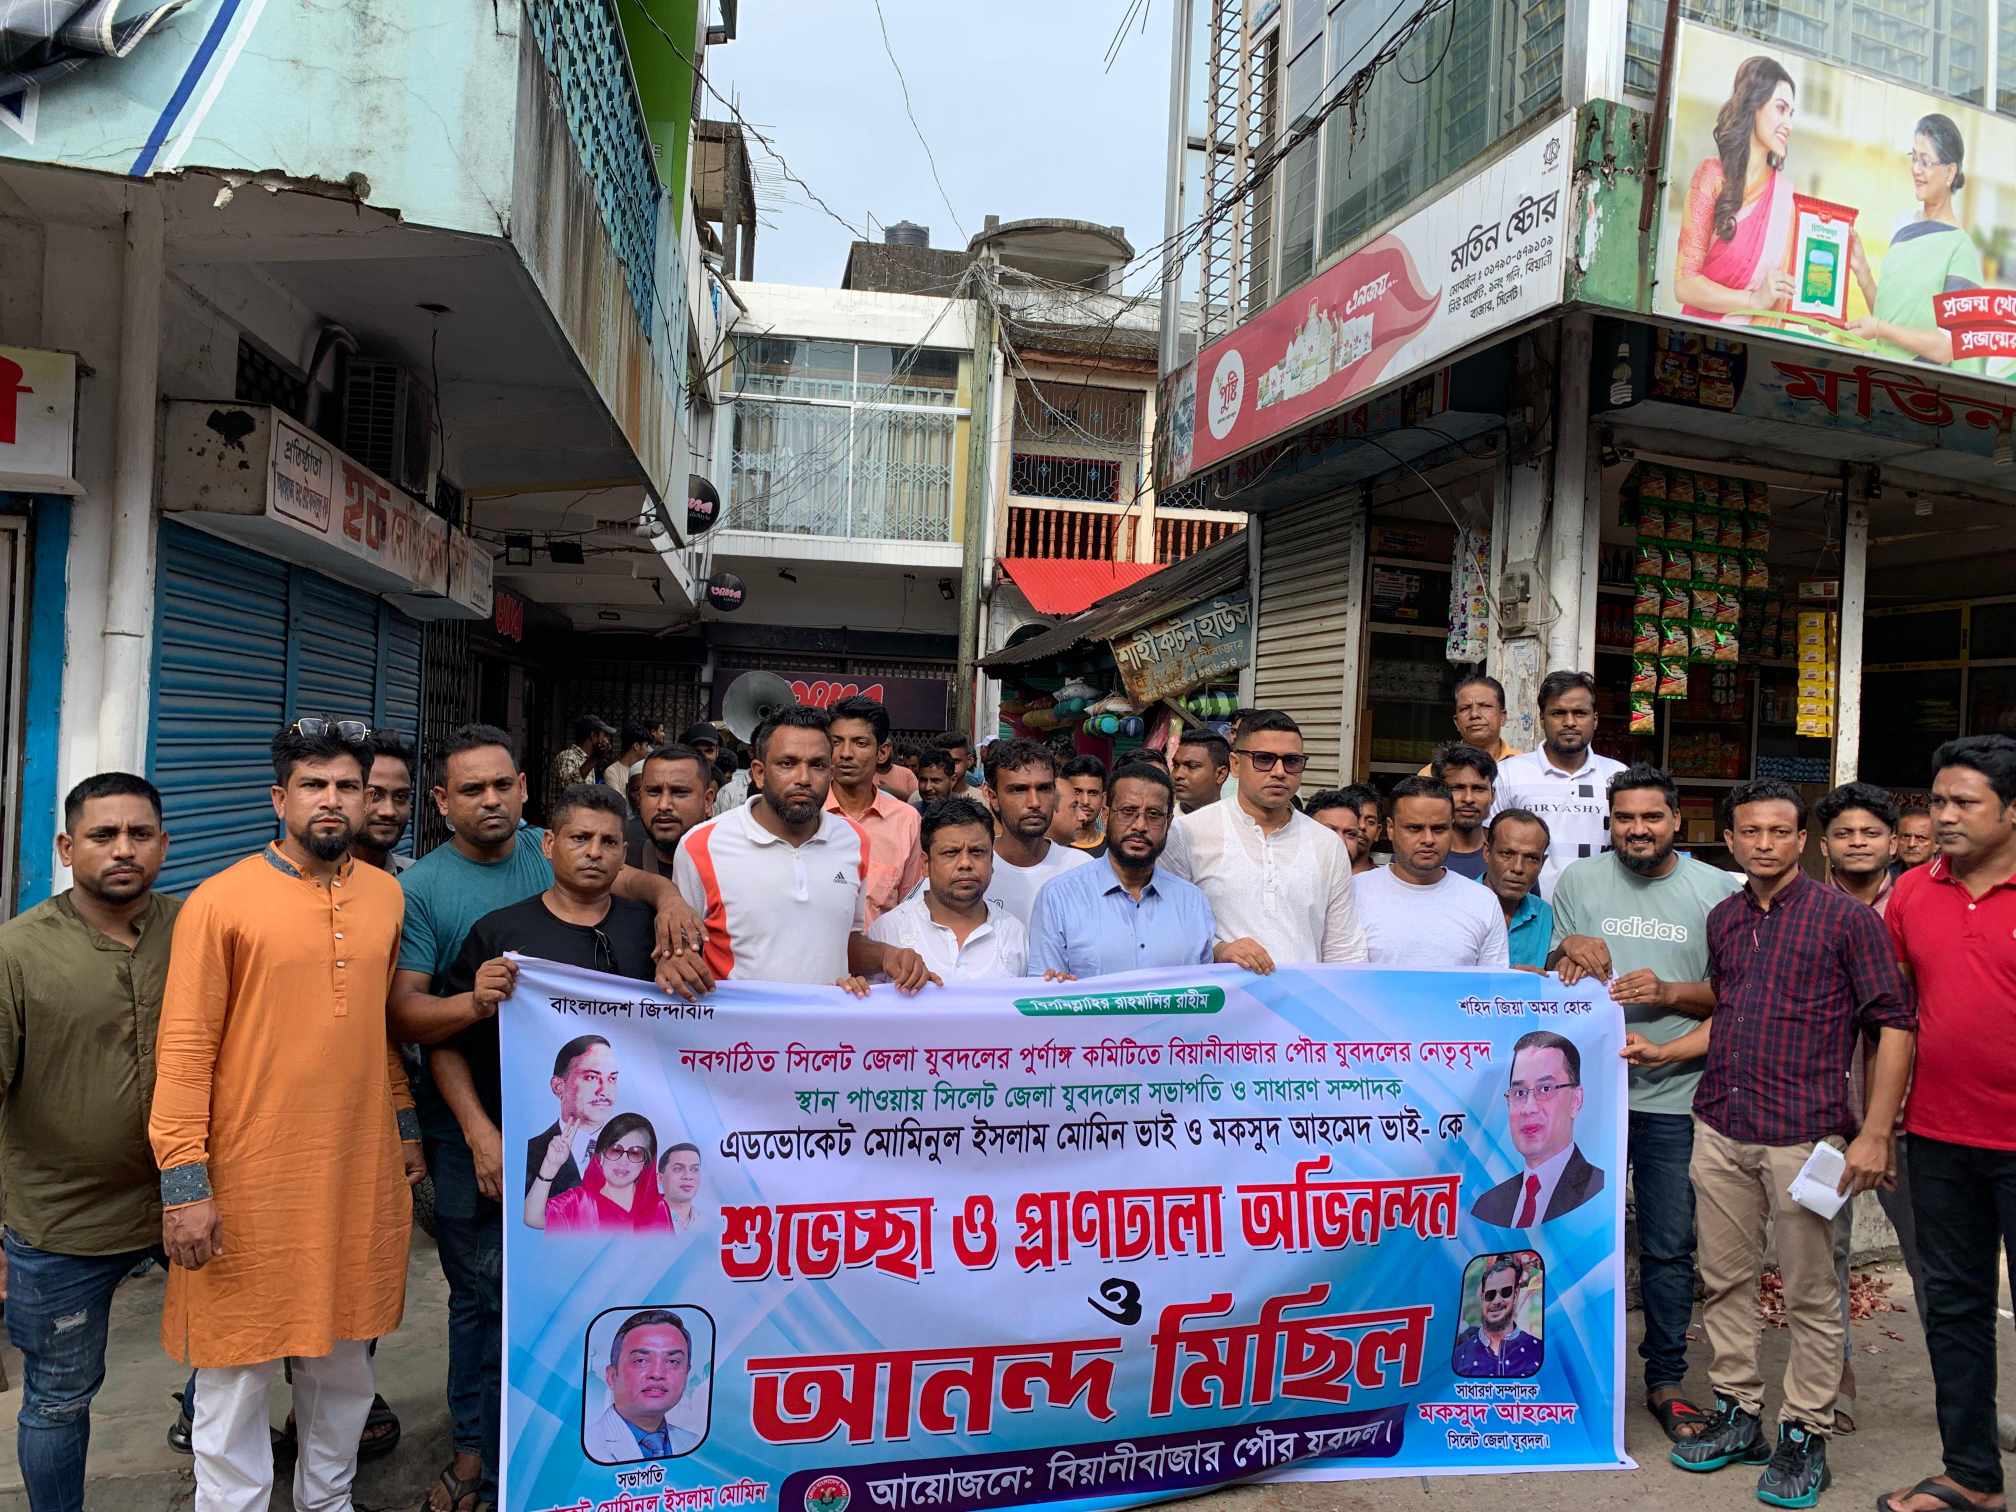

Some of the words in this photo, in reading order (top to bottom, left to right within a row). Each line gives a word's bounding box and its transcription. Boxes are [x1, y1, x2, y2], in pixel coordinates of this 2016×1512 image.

[1451, 221, 1501, 272] মতিন
[1506, 189, 1560, 242] ষ্টোর
[1943, 295, 1990, 318] প্রজন্ম
[1116, 628, 1161, 671] শাহী
[1196, 600, 1251, 641] হাউস
[1602, 916, 1687, 943] adidas
[549, 996, 634, 1018] বাংলাদেশ
[640, 997, 716, 1020] জিন্দাবাদ
[1458, 996, 1491, 1015] শহিদ
[1495, 996, 1524, 1015] জিয়া
[1528, 1000, 1558, 1015] অমর
[1563, 999, 1592, 1015] হোক
[679, 1041, 780, 1074] নবগঠিত
[786, 1041, 856, 1074] সিলেট
[863, 1046, 918, 1073] জেলা
[924, 1047, 1012, 1077] যুবদলের
[1081, 1037, 1163, 1068] কমিটিতে
[1168, 1035, 1278, 1066] বিয়ানীবাজার
[1286, 1035, 1327, 1064] পৌর
[1333, 1041, 1412, 1070] যুবদলের
[1419, 1041, 1491, 1071] নেতৃবৃন্দ
[795, 1088, 840, 1115] স্থান
[847, 1086, 928, 1113] পাওয়ায়
[934, 1080, 997, 1113] সিলেট
[1005, 1083, 1056, 1108] জেলা
[1061, 1082, 1142, 1112] যুবদলের
[1147, 1073, 1224, 1105] সভাপতি
[1231, 1079, 1247, 1101] ও
[1252, 1077, 1320, 1102] সাধারণ
[1325, 1077, 1403, 1101] সম্পাদক
[720, 1118, 856, 1163] এডভোকেট
[864, 1117, 964, 1164] মোমিনুল
[970, 1115, 1050, 1156] ইসলাম
[1057, 1111, 1128, 1150] মোমিন
[1133, 1109, 1177, 1149] ভাই
[1184, 1118, 1202, 1146] ও
[1208, 1116, 1282, 1153] মকসুদ
[1288, 1112, 1373, 1146] আহমেদ
[1438, 1113, 1466, 1141] কে
[720, 1197, 936, 1283] শুভেচ্ছা
[952, 1195, 1001, 1271] ও
[1014, 1185, 1225, 1273] প্রাণঢালা
[1237, 1155, 1463, 1253] অভিনন্দন
[1087, 1278, 1142, 1326] ও
[747, 1335, 1123, 1445] আনন্দ
[1150, 1284, 1434, 1418] মিছিল
[1456, 1384, 1493, 1399] সাধারণ
[1495, 1384, 1539, 1400] সম্পাদক
[1418, 1403, 1489, 1427] মকসুদ
[1495, 1402, 1578, 1424] আহমেদ
[1447, 1430, 1479, 1449] সিলেট
[1483, 1433, 1509, 1448] জেলা
[617, 1465, 665, 1488] সভাপতি
[866, 1465, 1034, 1511] আয়োজনে:
[1046, 1442, 1226, 1491] বিয়ানীবাজার
[1232, 1426, 1299, 1469] পৌর
[1304, 1419, 1394, 1457] যবদল।
[664, 1485, 715, 1512] ইসলাম
[719, 1478, 768, 1505] মোমিন
